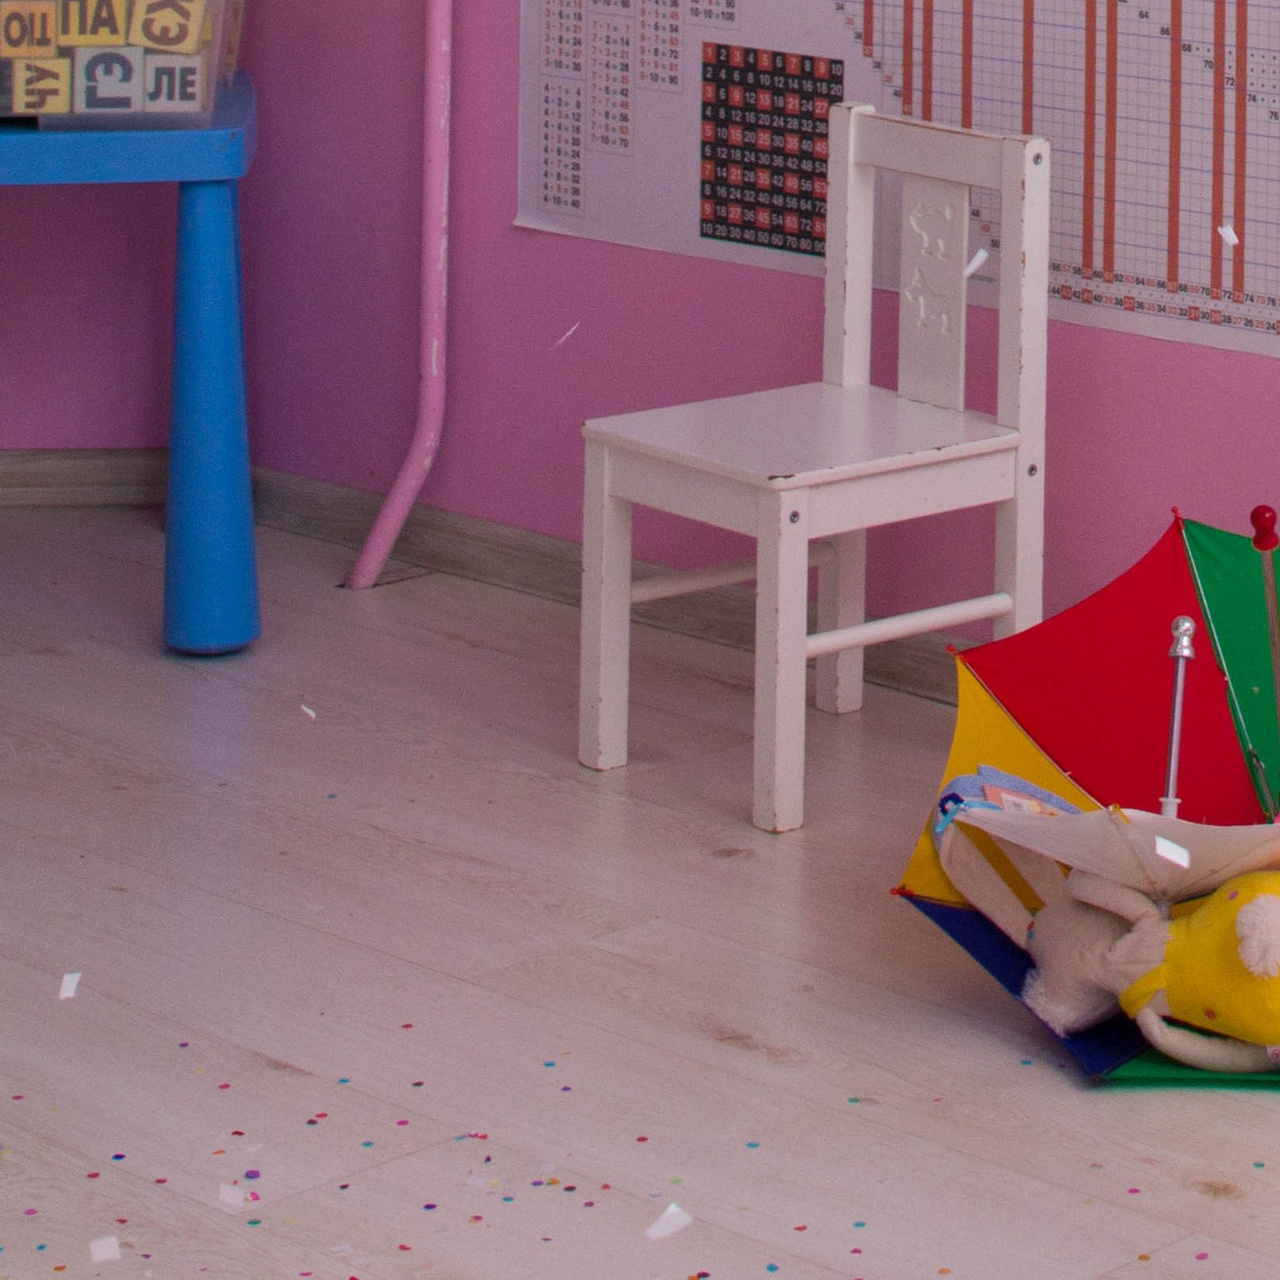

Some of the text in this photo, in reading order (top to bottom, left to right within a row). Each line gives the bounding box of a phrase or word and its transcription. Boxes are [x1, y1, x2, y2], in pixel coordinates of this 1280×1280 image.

[706, 47, 843, 75] 1 2 3 4 5 6 7 8 9 10
[25, 63, 59, 109] ЧУ
[85, 52, 134, 109] ГЭ
[147, 66, 196, 101] ЛЕ
[706, 67, 842, 95] 2 4 6 8 10 12 14 16 18 20
[705, 107, 827, 134] 4 8 12 16 20 24 28 32 36
[701, 223, 826, 251] 10 20 30 40 50 60 70 80 90
